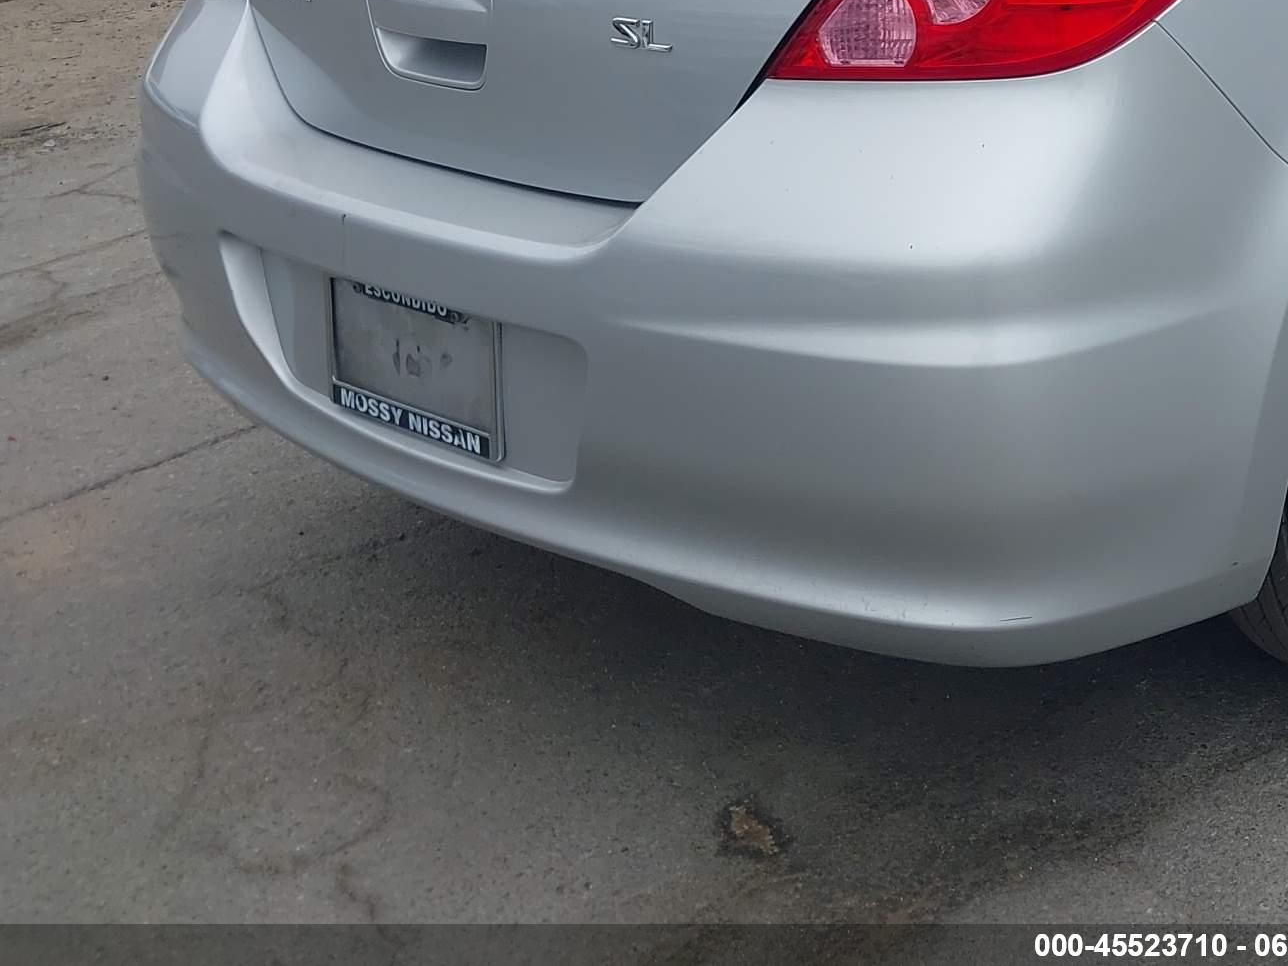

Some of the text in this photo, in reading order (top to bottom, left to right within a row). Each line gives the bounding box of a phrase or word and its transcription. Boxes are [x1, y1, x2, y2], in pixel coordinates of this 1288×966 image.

[610, 17, 673, 53] SL
[341, 387, 481, 455] MOSSY NISSAN
